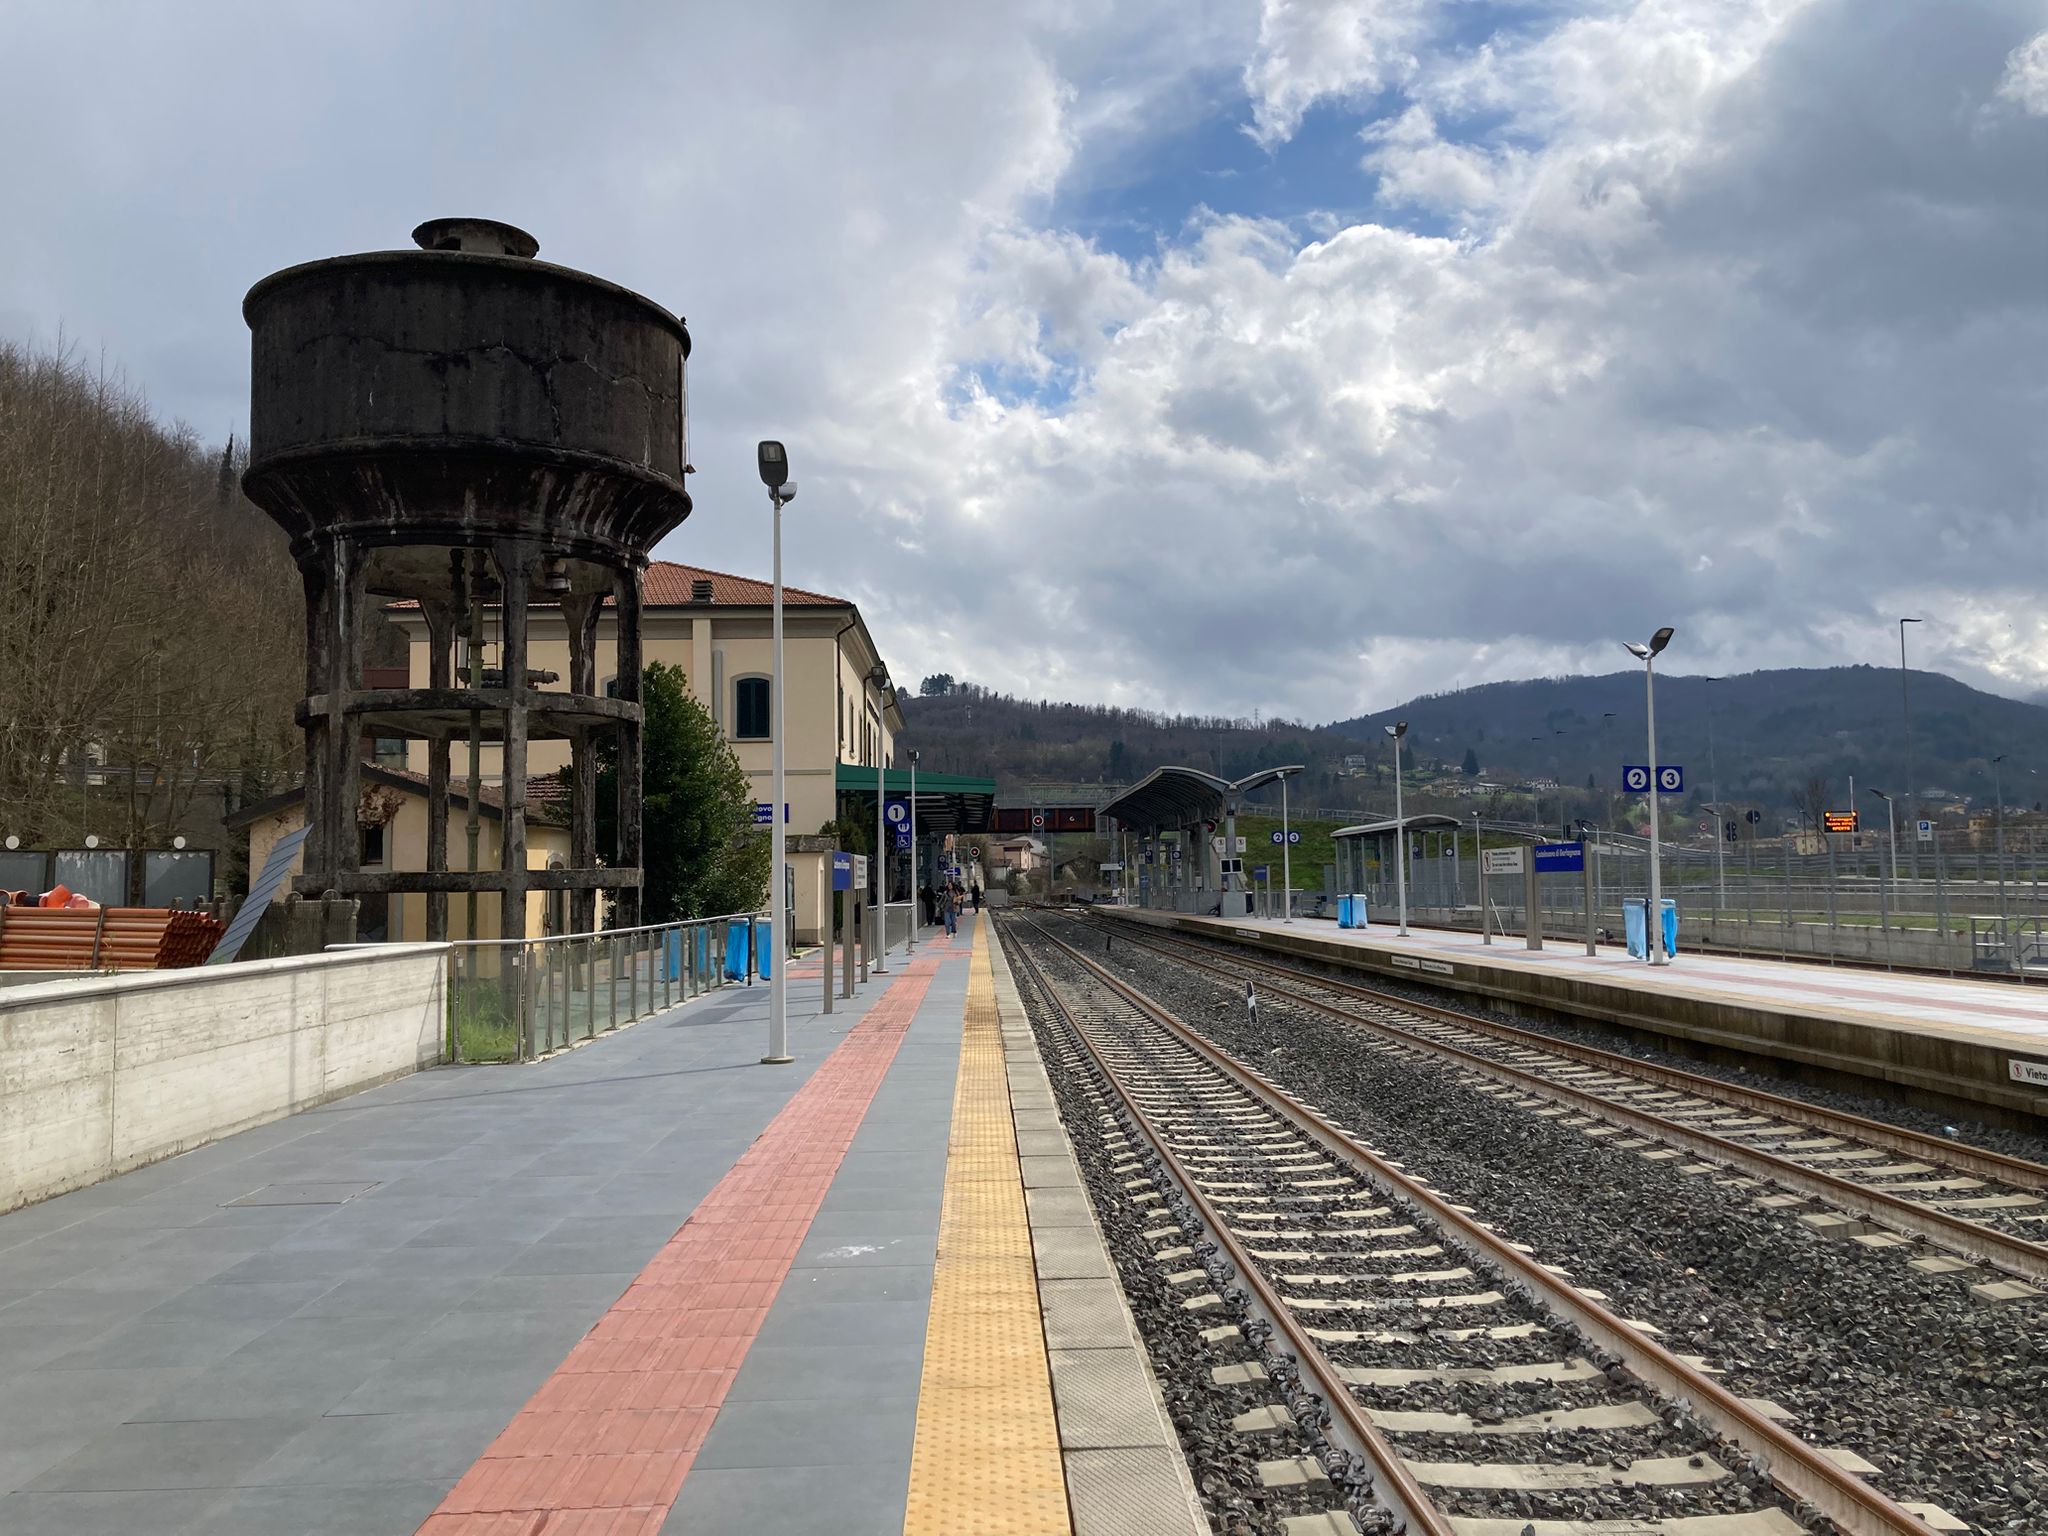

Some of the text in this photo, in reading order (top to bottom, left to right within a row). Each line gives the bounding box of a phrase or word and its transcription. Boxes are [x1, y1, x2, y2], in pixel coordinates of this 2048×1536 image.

[1632, 772, 1676, 786] 2 3
[893, 807, 899, 819] 1
[2026, 1067, 2048, 1081] Vieta
